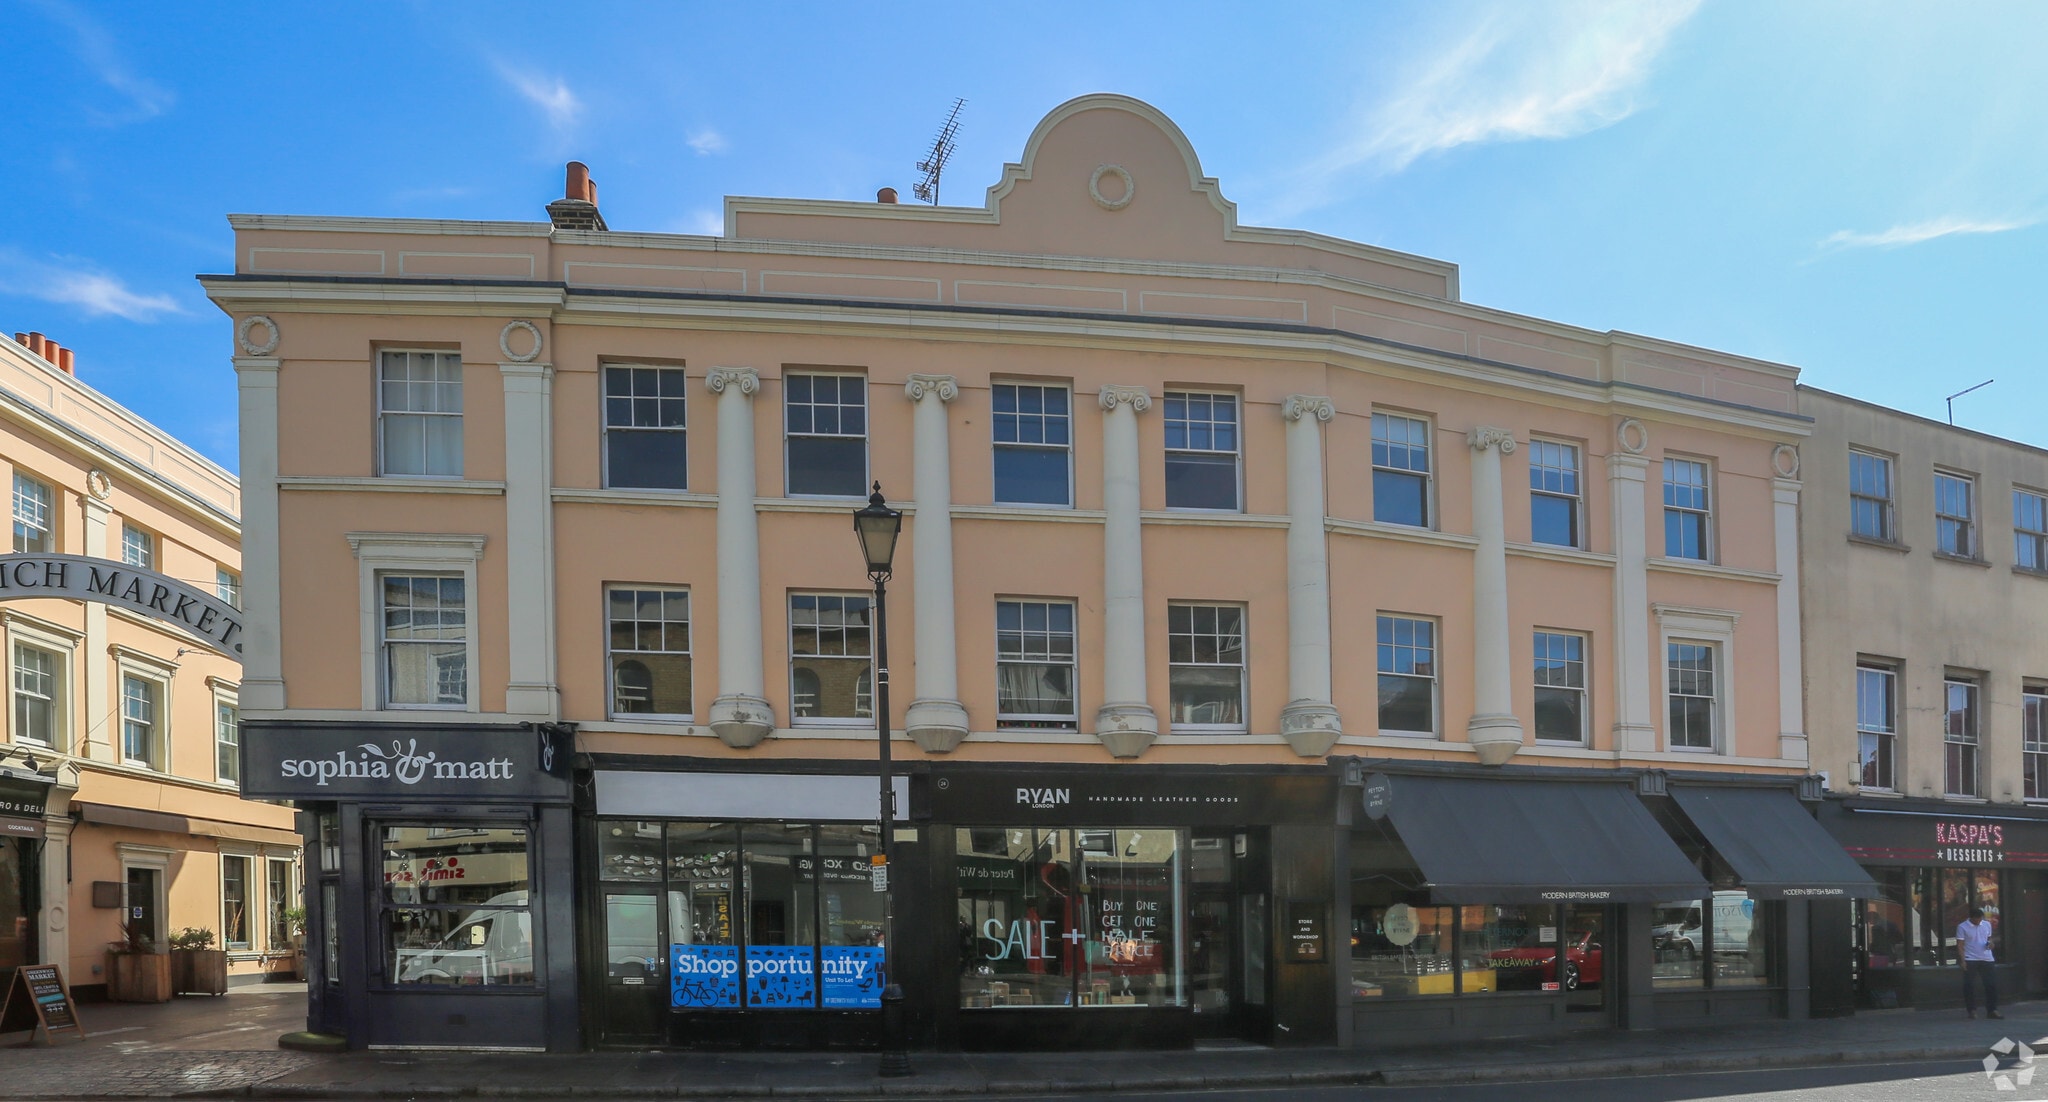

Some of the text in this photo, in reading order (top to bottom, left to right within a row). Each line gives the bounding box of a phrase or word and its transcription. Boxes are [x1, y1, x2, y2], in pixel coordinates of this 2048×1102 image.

[86, 566, 242, 645] MARKET
[281, 738, 514, 786] sophia & matt
[1016, 788, 1070, 804] RYAN
[1368, 785, 1385, 794] PEYTON
[23, 804, 44, 813] DELI
[7, 824, 34, 832] COCKTAILS
[1936, 823, 2003, 846] KASPA'S
[1946, 848, 1994, 862] DESSERTS
[1568, 891, 1589, 899] BRITISH
[1589, 891, 1610, 899] BAKERY
[1102, 899, 1124, 912] BUY
[1102, 914, 1156, 927] GET ONE
[983, 918, 1057, 961] SALE
[1101, 930, 1154, 942] HALF
[678, 955, 738, 978] Shop
[746, 956, 812, 977] portu
[822, 956, 868, 979] nity
[1488, 958, 1535, 968] TAKEAWAY
